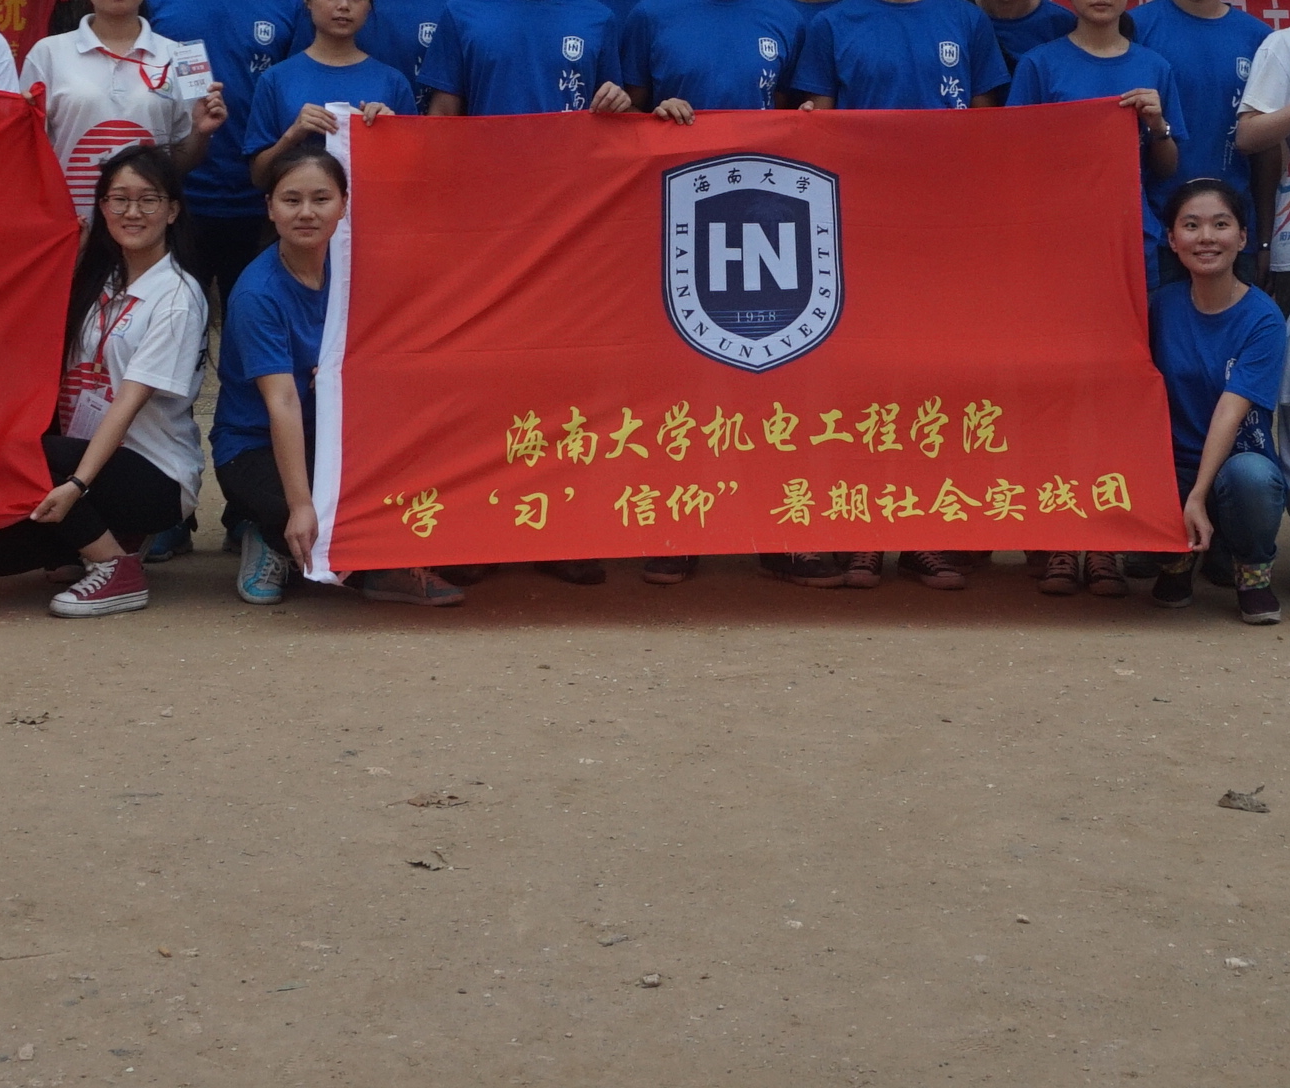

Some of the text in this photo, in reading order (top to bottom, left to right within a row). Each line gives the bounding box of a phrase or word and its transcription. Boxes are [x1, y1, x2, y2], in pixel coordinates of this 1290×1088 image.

[693, 167, 811, 194] 海南大学
[675, 223, 709, 337] HAINAN
[708, 221, 799, 292] HN
[718, 224, 831, 358] UNIVERSITY
[736, 311, 776, 323] 1958
[505, 395, 1008, 467] 海南大学机电工程学院
